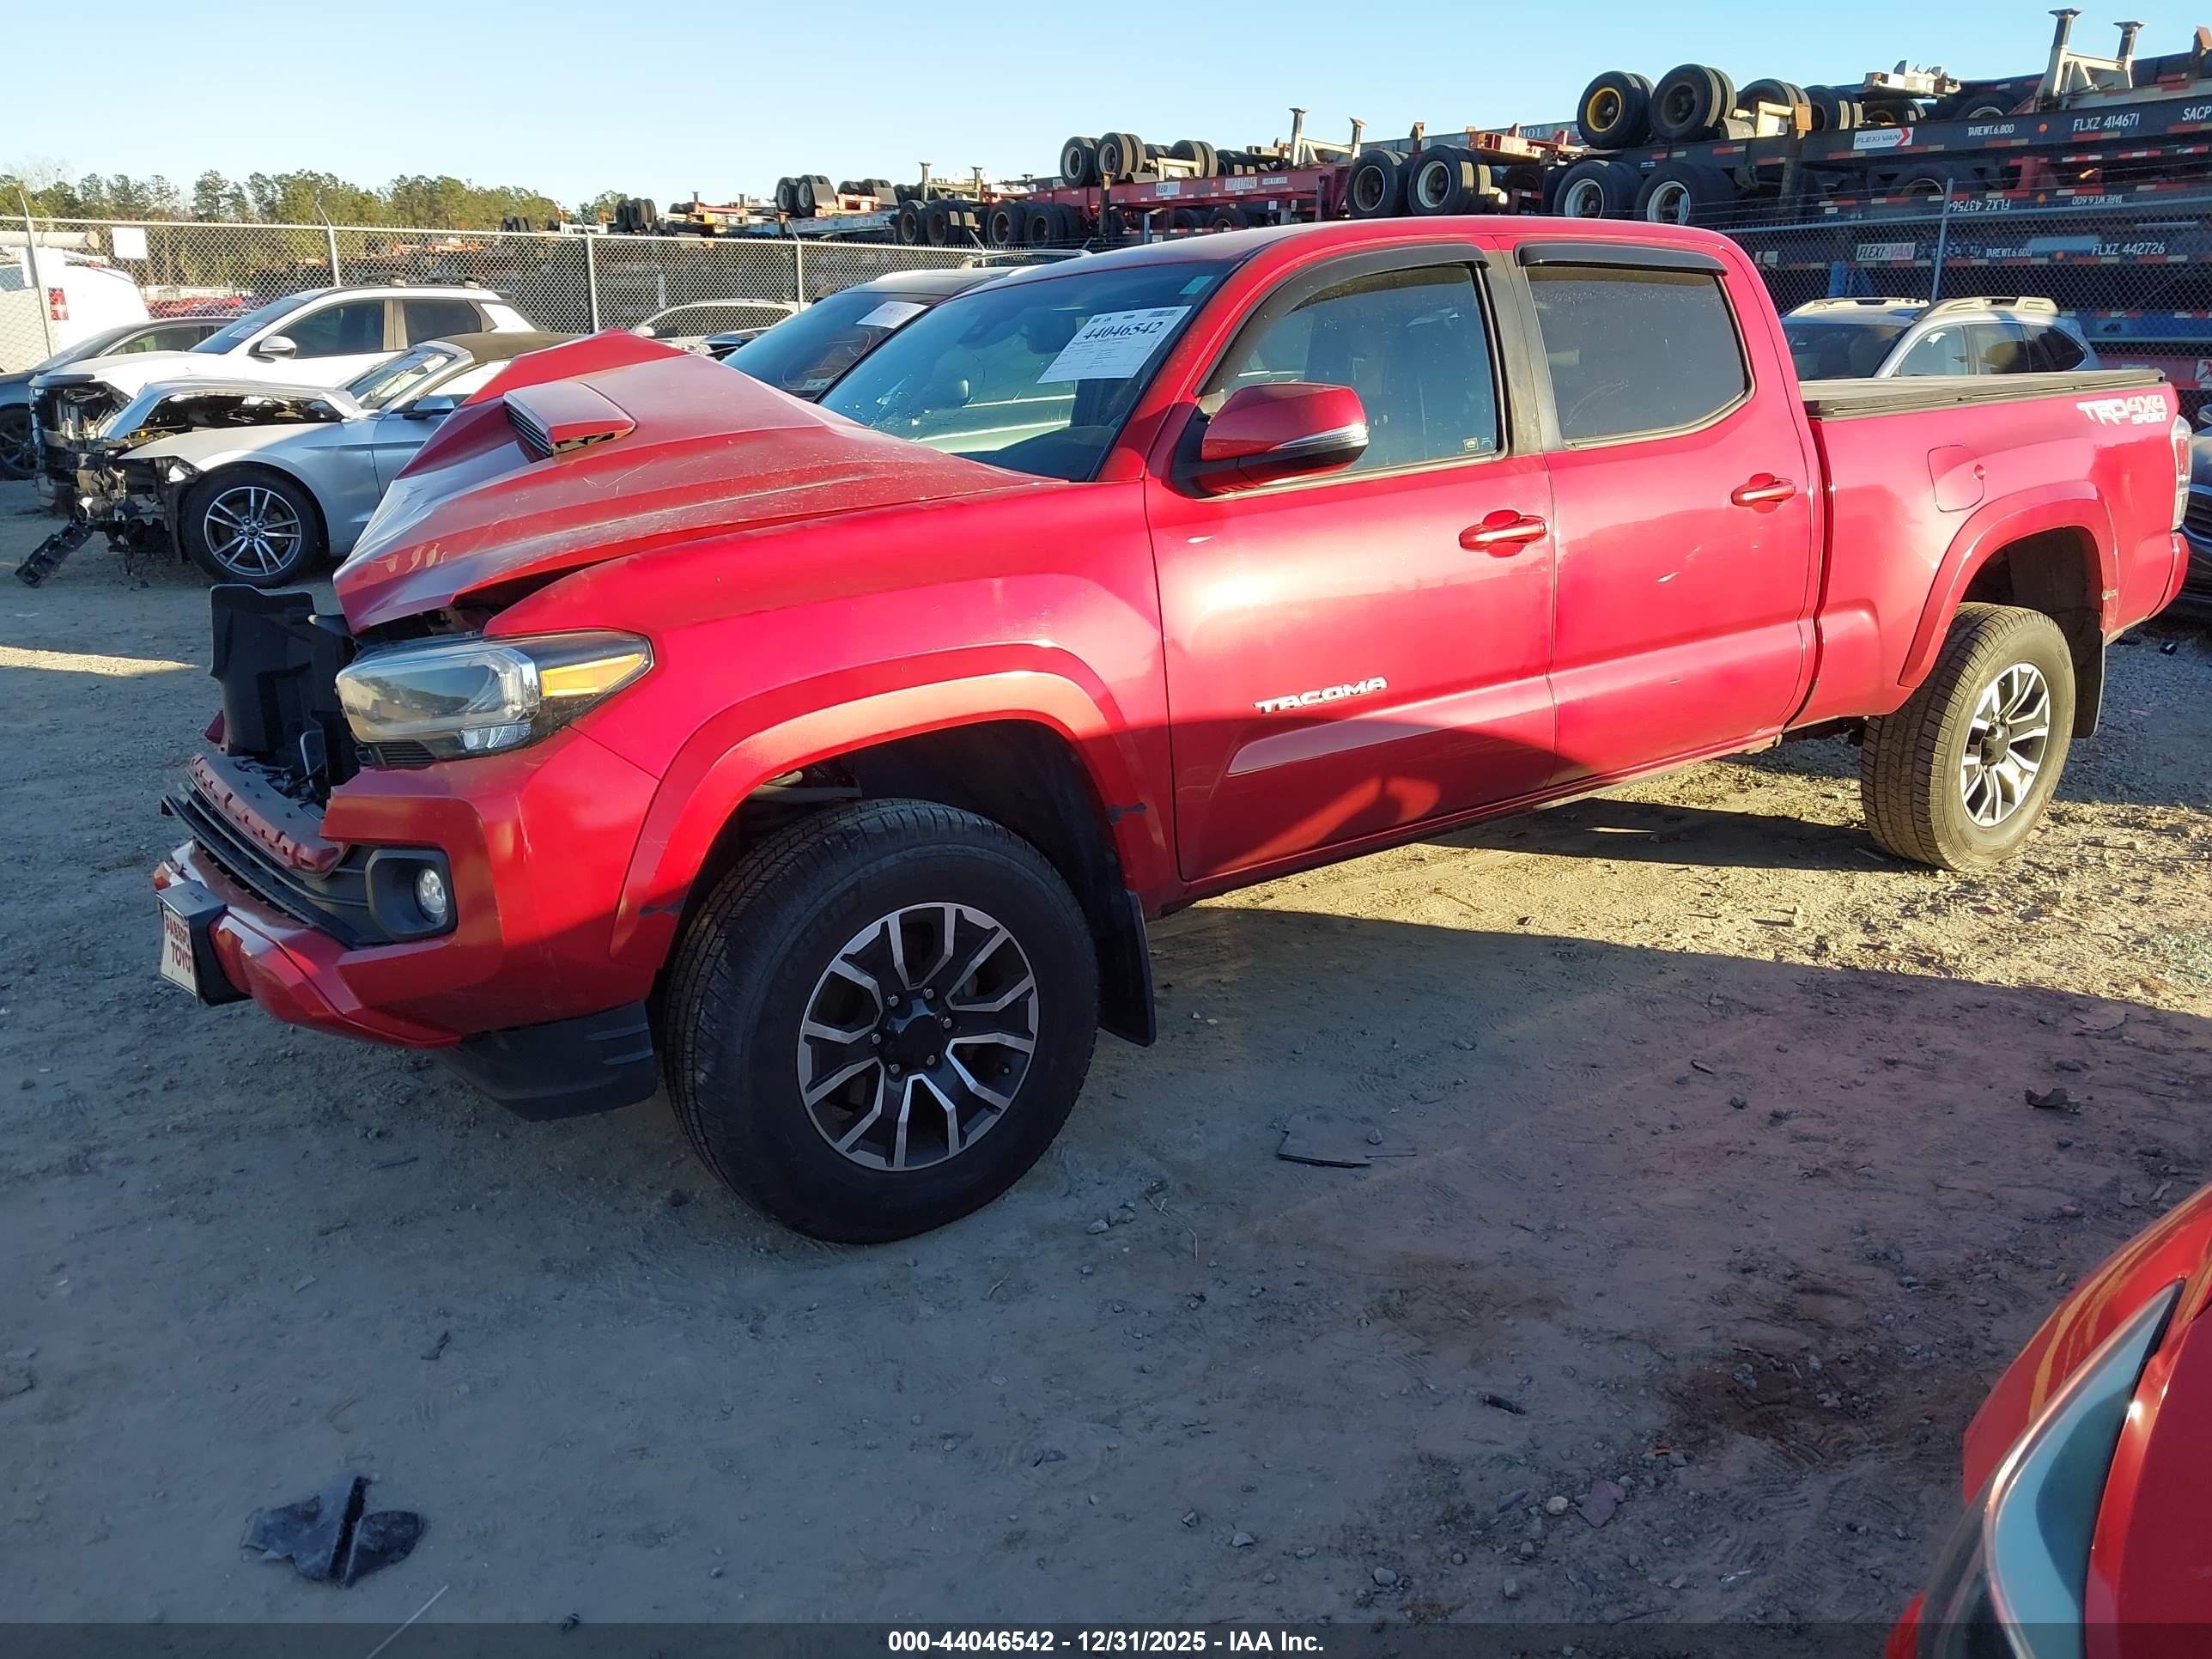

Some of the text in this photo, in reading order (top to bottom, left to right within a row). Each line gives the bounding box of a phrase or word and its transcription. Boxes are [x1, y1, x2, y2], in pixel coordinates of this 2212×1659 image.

[2073, 112, 2140, 131] FLXZ 414671
[1985, 198, 2010, 211] FLXZ
[2092, 241, 2166, 255] FLXZ 442726
[1083, 320, 1164, 340] 44046542
[2076, 398, 2130, 426] TRD
[2131, 412, 2167, 424] SPORT
[1254, 675, 1388, 714] TACOMA
